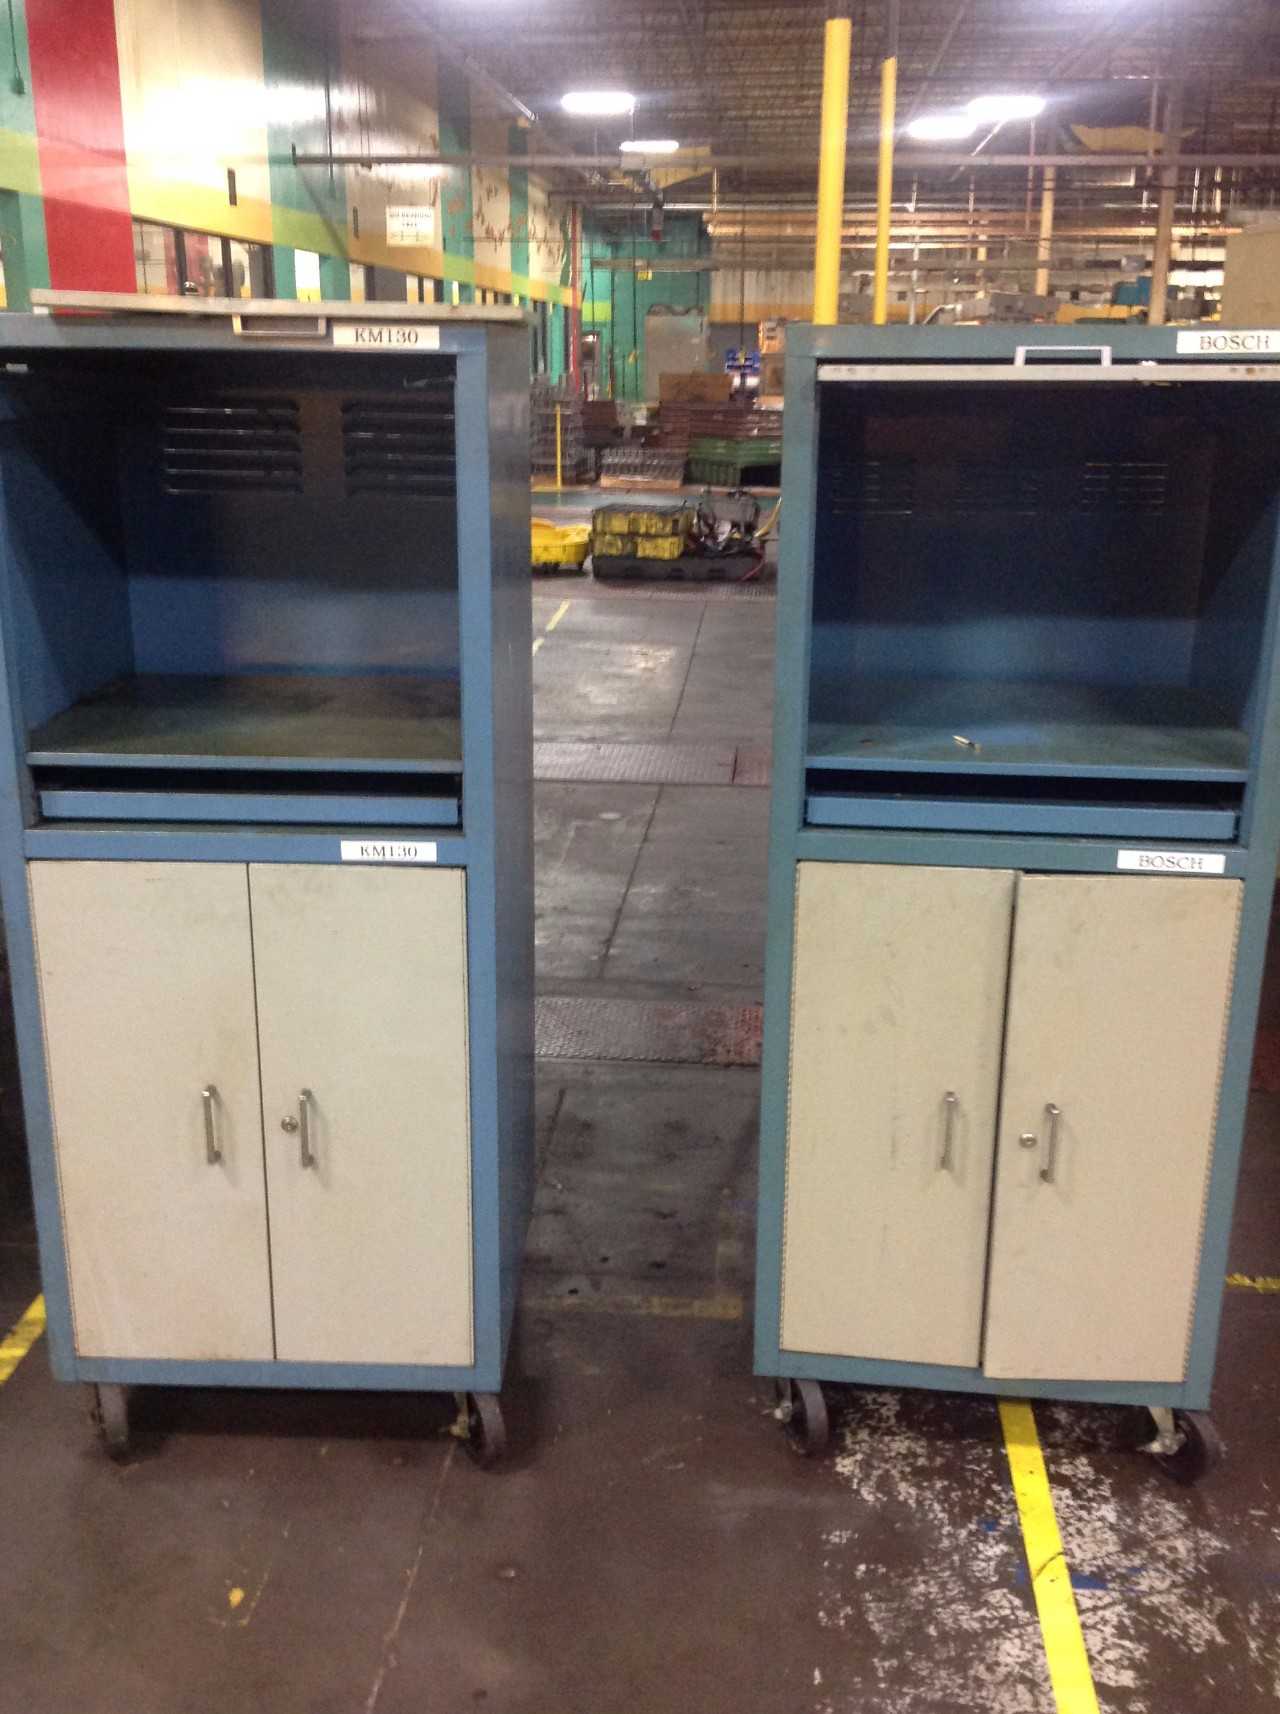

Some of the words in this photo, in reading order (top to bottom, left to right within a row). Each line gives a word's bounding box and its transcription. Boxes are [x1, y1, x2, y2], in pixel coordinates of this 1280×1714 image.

[354, 327, 418, 343] KM130
[1200, 335, 1270, 351] BOSCH
[361, 845, 418, 857] KM130
[1138, 855, 1204, 870] BOSCH
